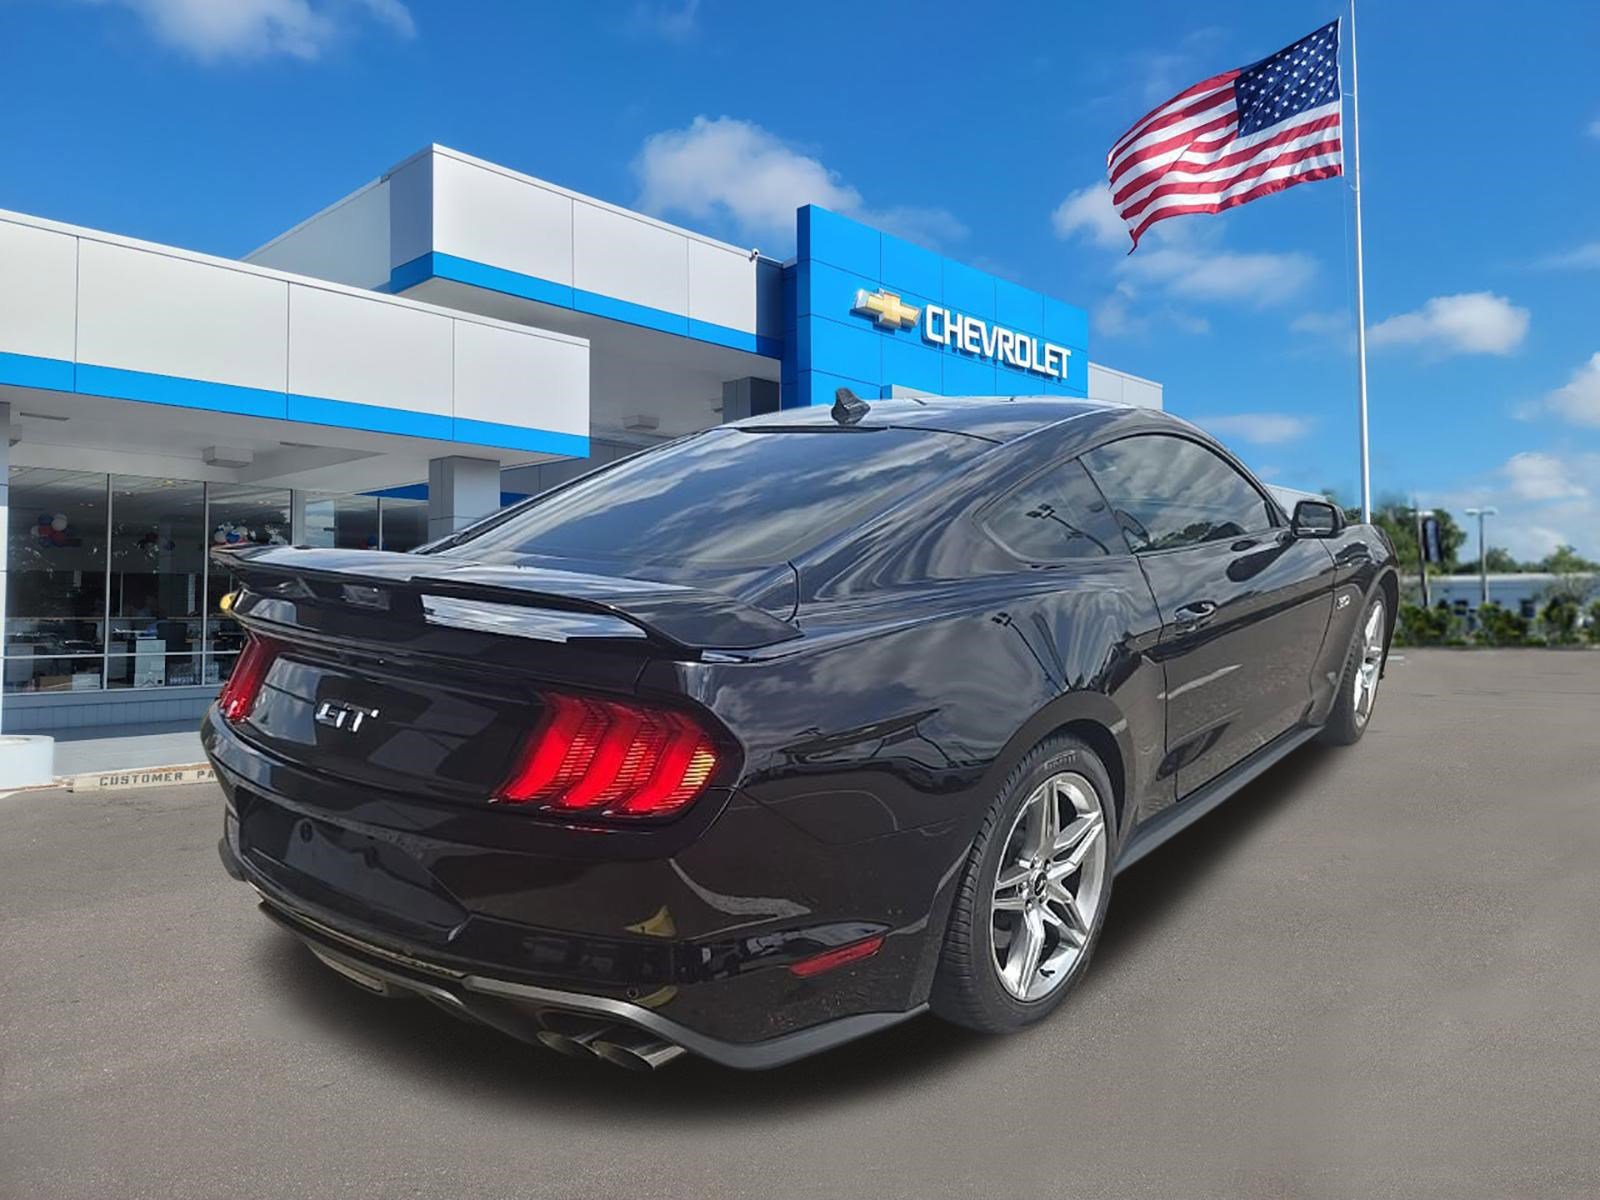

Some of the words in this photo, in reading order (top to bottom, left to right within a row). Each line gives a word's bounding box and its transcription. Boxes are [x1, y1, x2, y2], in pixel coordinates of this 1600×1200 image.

[925, 304, 1071, 378] CHEVROLET
[315, 700, 379, 732] GT
[100, 772, 182, 786] CUSTOMER
